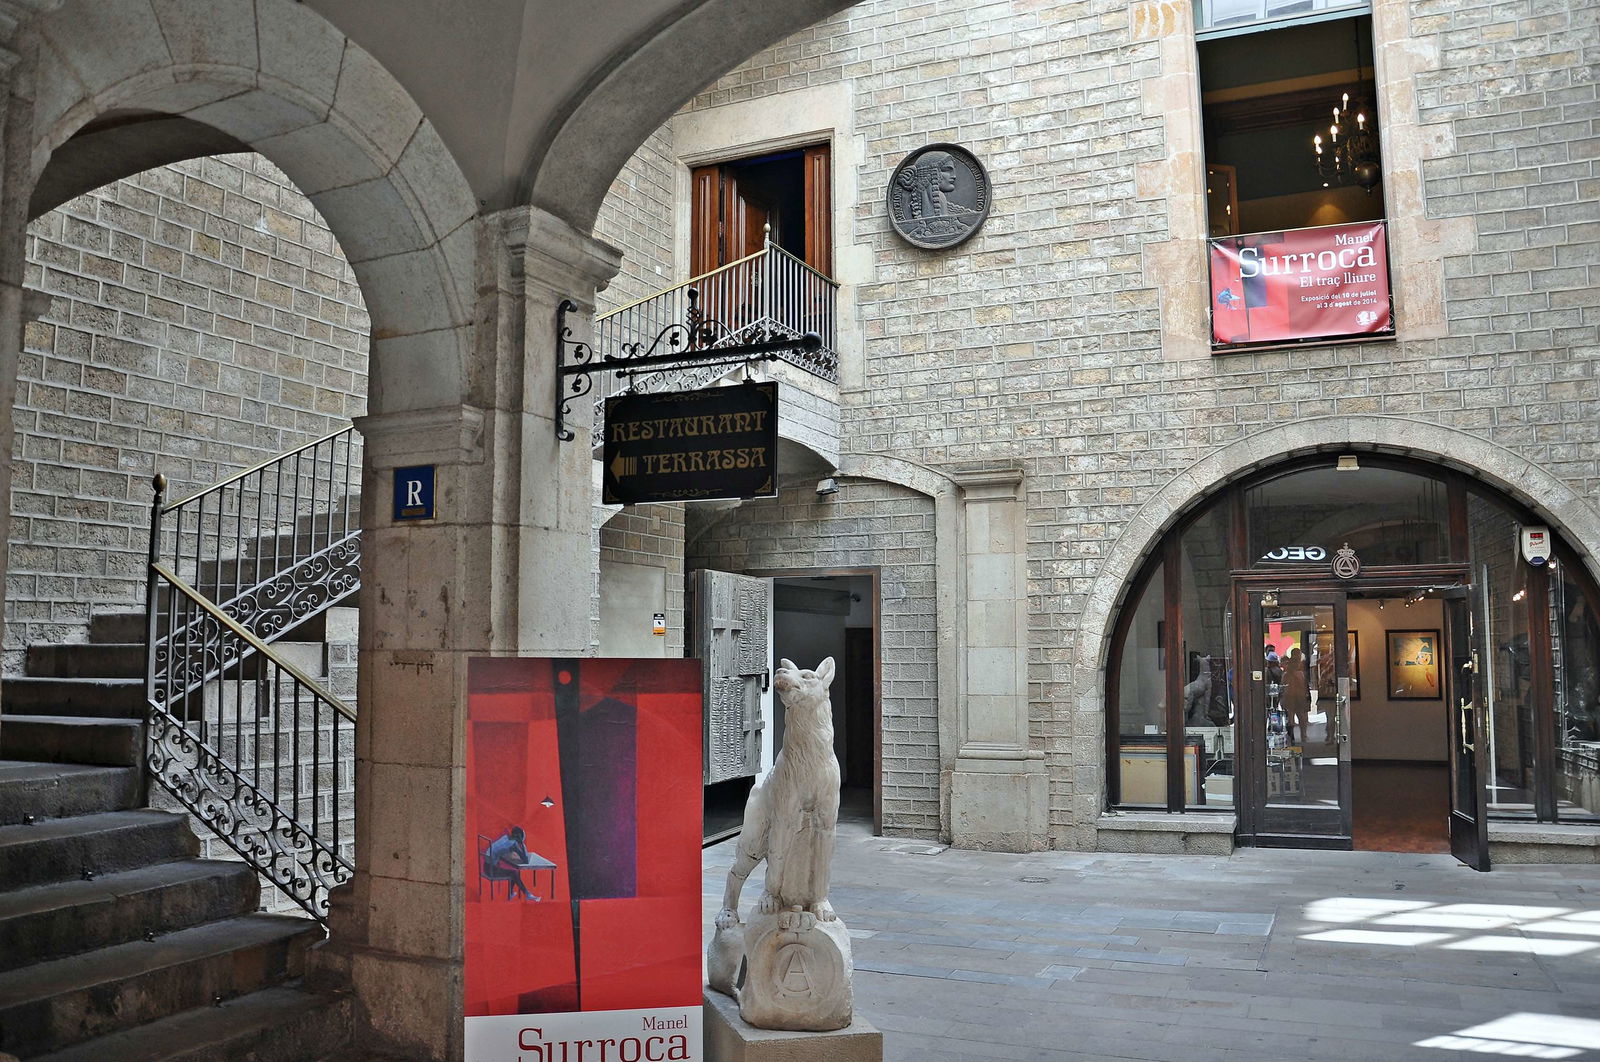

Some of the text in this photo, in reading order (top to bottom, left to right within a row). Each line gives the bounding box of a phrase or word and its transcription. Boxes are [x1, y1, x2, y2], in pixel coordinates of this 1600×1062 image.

[1335, 231, 1373, 246] Manel
[1238, 245, 1377, 278] Surroca
[1300, 272, 1376, 287] El traç lliure
[1301, 294, 1330, 302] Exposició
[1360, 290, 1377, 298] juliol
[611, 411, 767, 442] RESTAURANT
[642, 447, 766, 475] TERRASSA
[406, 480, 423, 506] R
[642, 1015, 688, 1030] Manel
[518, 1028, 690, 1062] Surroca
